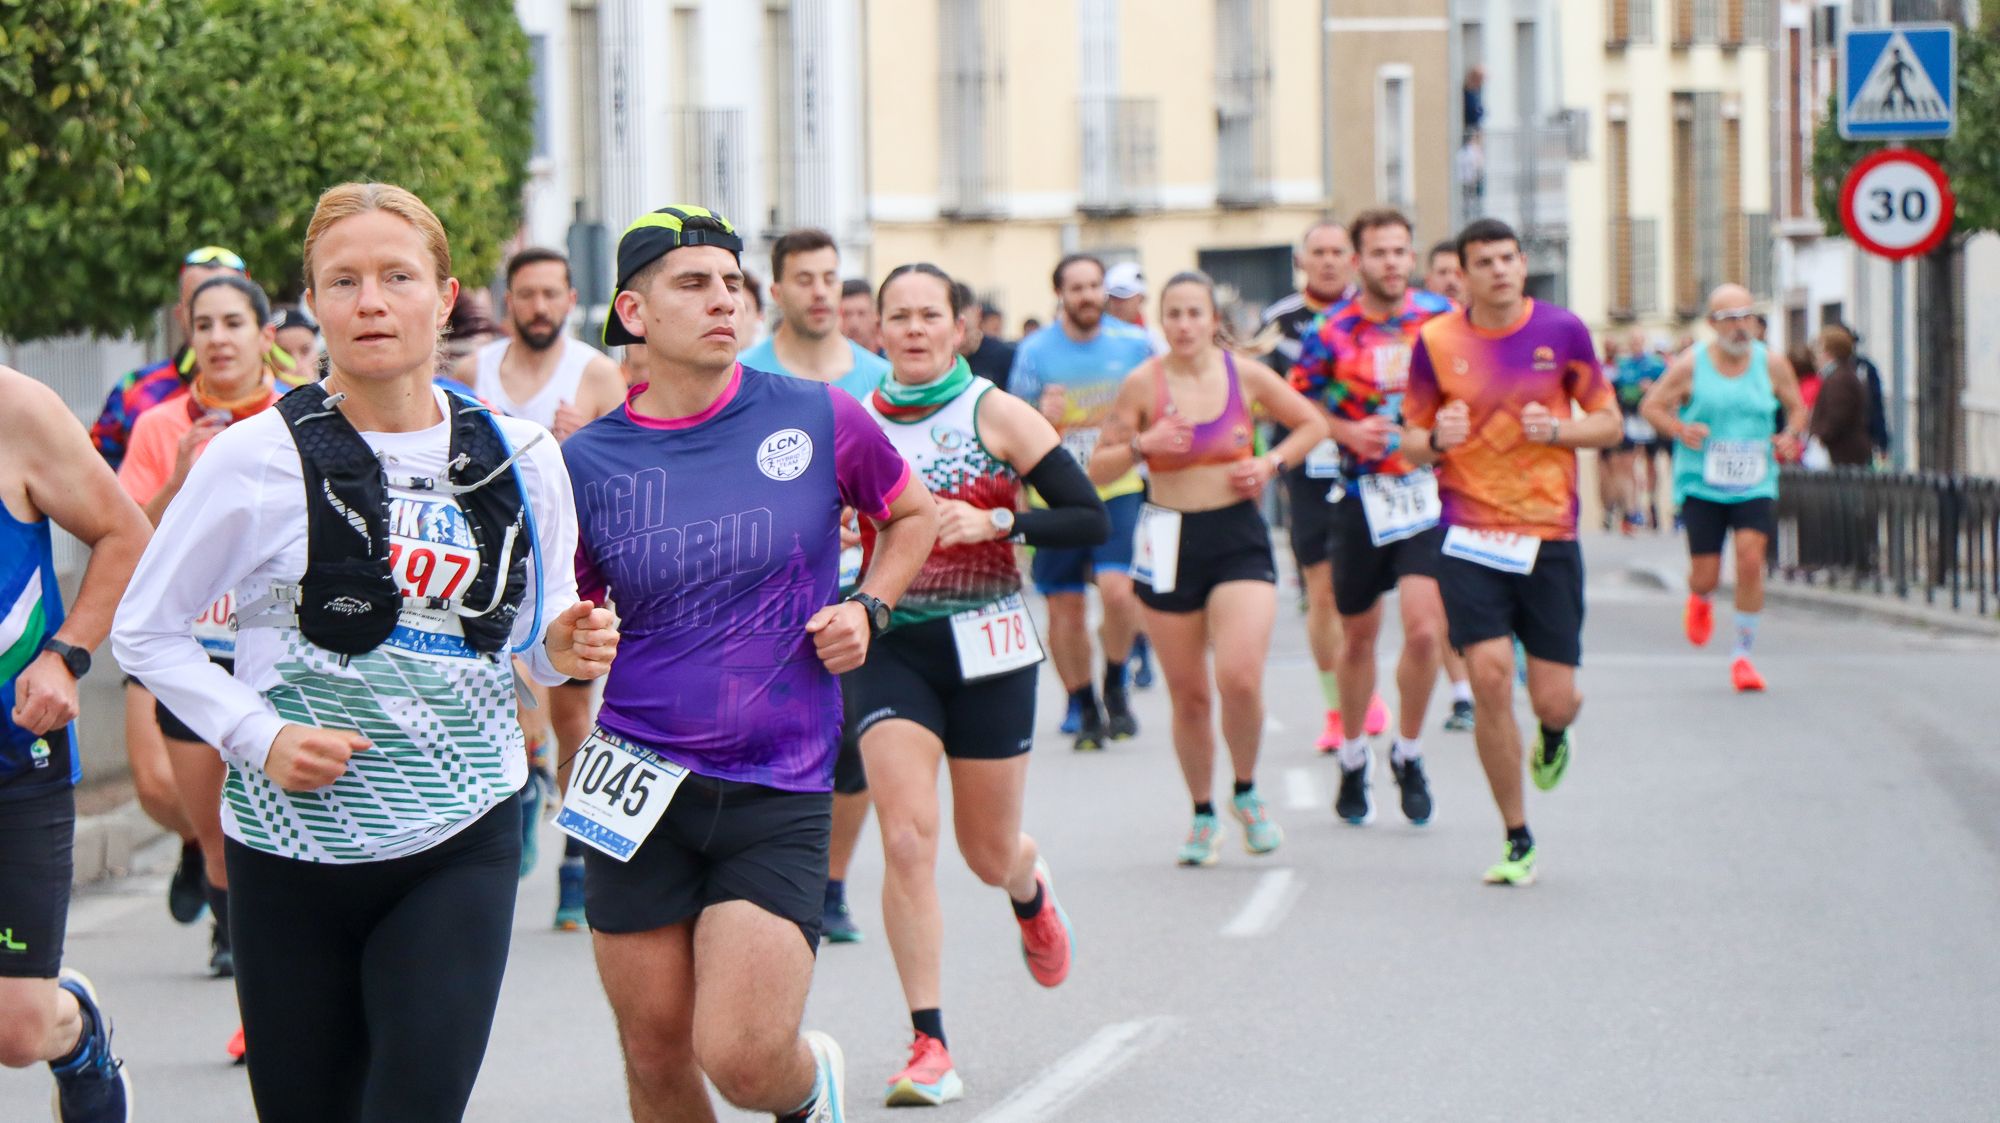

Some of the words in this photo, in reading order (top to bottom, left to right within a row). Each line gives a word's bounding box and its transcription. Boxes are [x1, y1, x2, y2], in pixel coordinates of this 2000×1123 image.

[1871, 189, 1926, 223] 30
[768, 434, 798, 452] LCN
[584, 467, 667, 548] LCN
[980, 612, 1026, 657] 178
[573, 744, 658, 817] 1045
